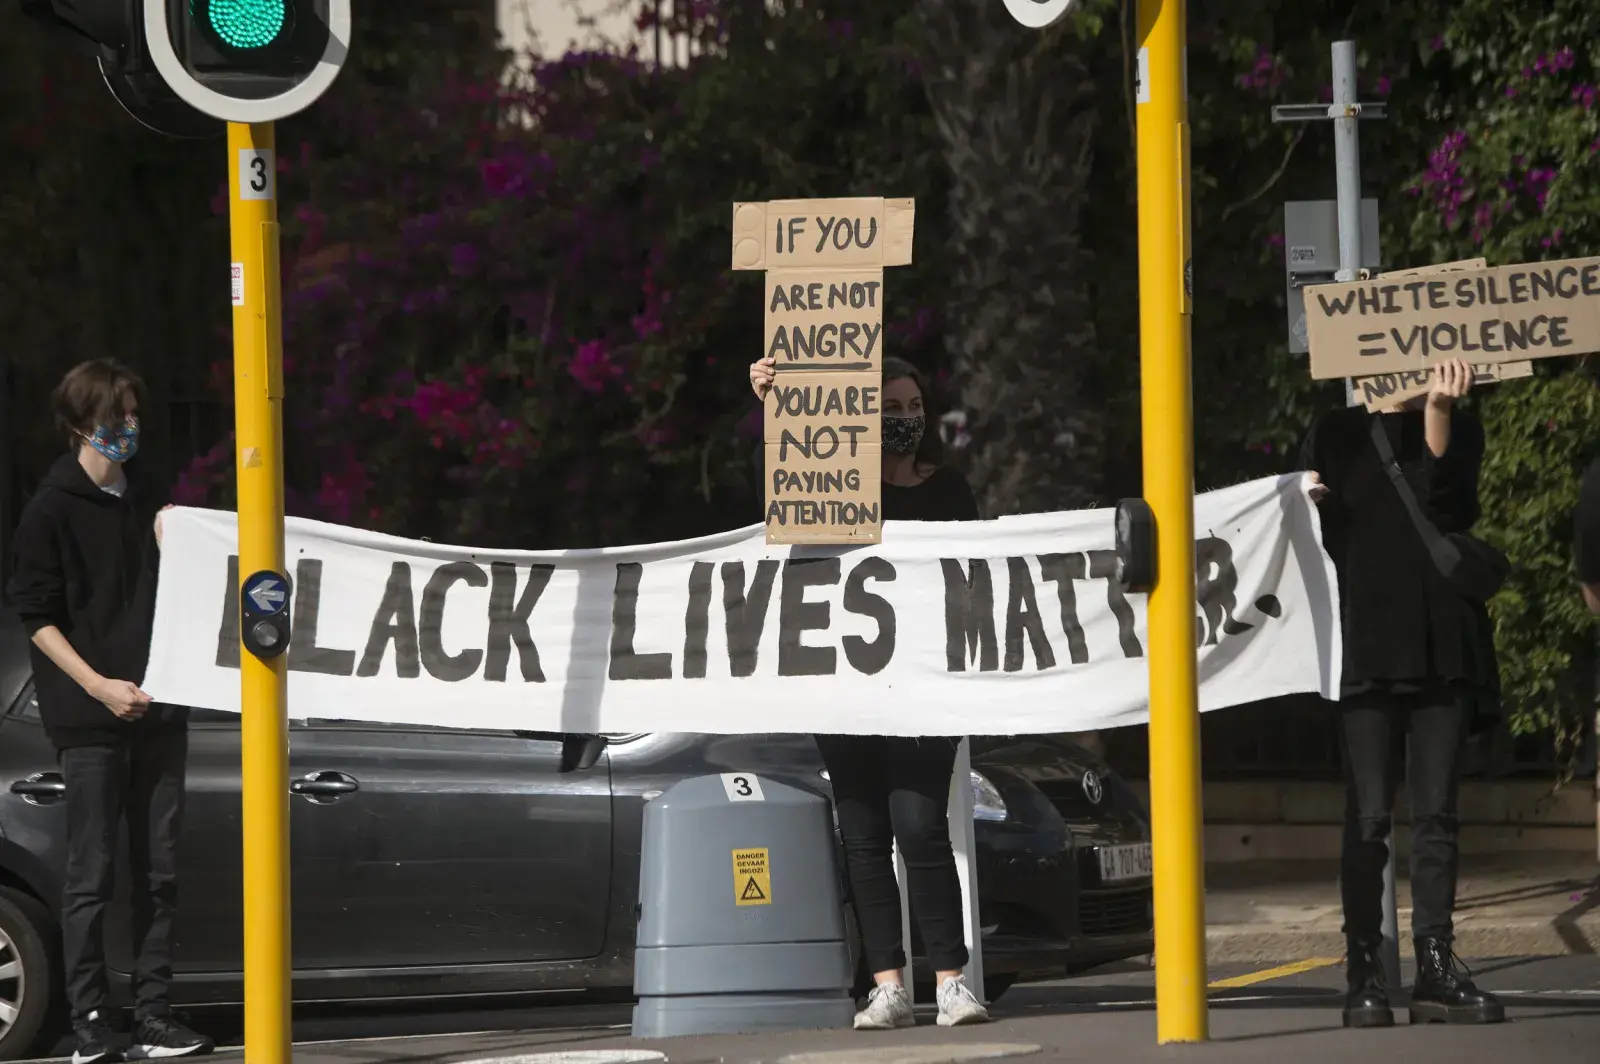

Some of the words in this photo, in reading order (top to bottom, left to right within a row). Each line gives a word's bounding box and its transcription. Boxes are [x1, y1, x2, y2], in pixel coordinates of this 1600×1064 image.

[250, 157, 267, 192] 3
[776, 217, 808, 254] IF
[815, 216, 878, 253] YOU
[770, 283, 823, 313] ARE
[827, 281, 881, 309] NOT
[1317, 281, 1450, 317] WHITE
[1455, 265, 1600, 308] SILENCE
[767, 322, 882, 361] ANGRY
[1390, 314, 1573, 357] VIOLENCE
[773, 386, 823, 419] YOU
[823, 386, 880, 416] ARE
[1362, 375, 1398, 404] NO
[779, 425, 868, 462] NOT
[773, 469, 861, 496] PAYING
[766, 499, 879, 526] ATTENTION
[216, 554, 556, 683] LACK
[608, 555, 897, 681] LIVES
[733, 776, 753, 797] 3
[736, 852, 765, 860] DANGER
[737, 860, 765, 868] GEVAAR
